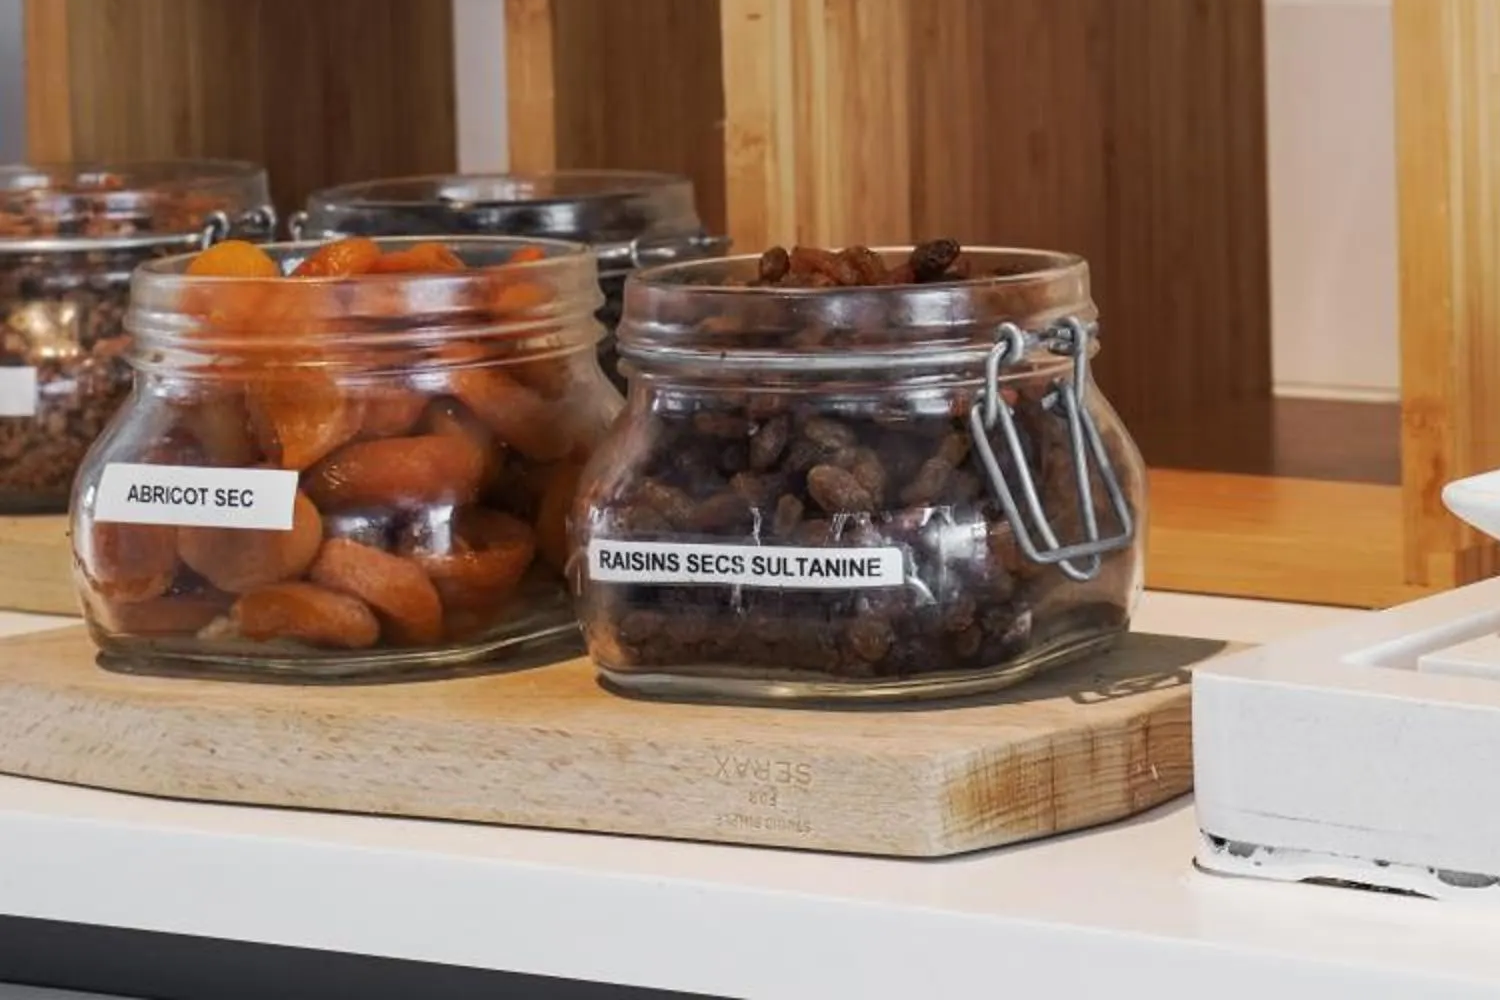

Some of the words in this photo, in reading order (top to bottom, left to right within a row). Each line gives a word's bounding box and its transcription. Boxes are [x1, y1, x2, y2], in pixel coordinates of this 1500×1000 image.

[127, 484, 208, 506] ABRICOT
[214, 488, 255, 508] SEC
[599, 550, 681, 573] RAISINS
[686, 553, 746, 576] SECS
[750, 555, 882, 578] SULTANINE
[713, 756, 812, 786] SERAX
